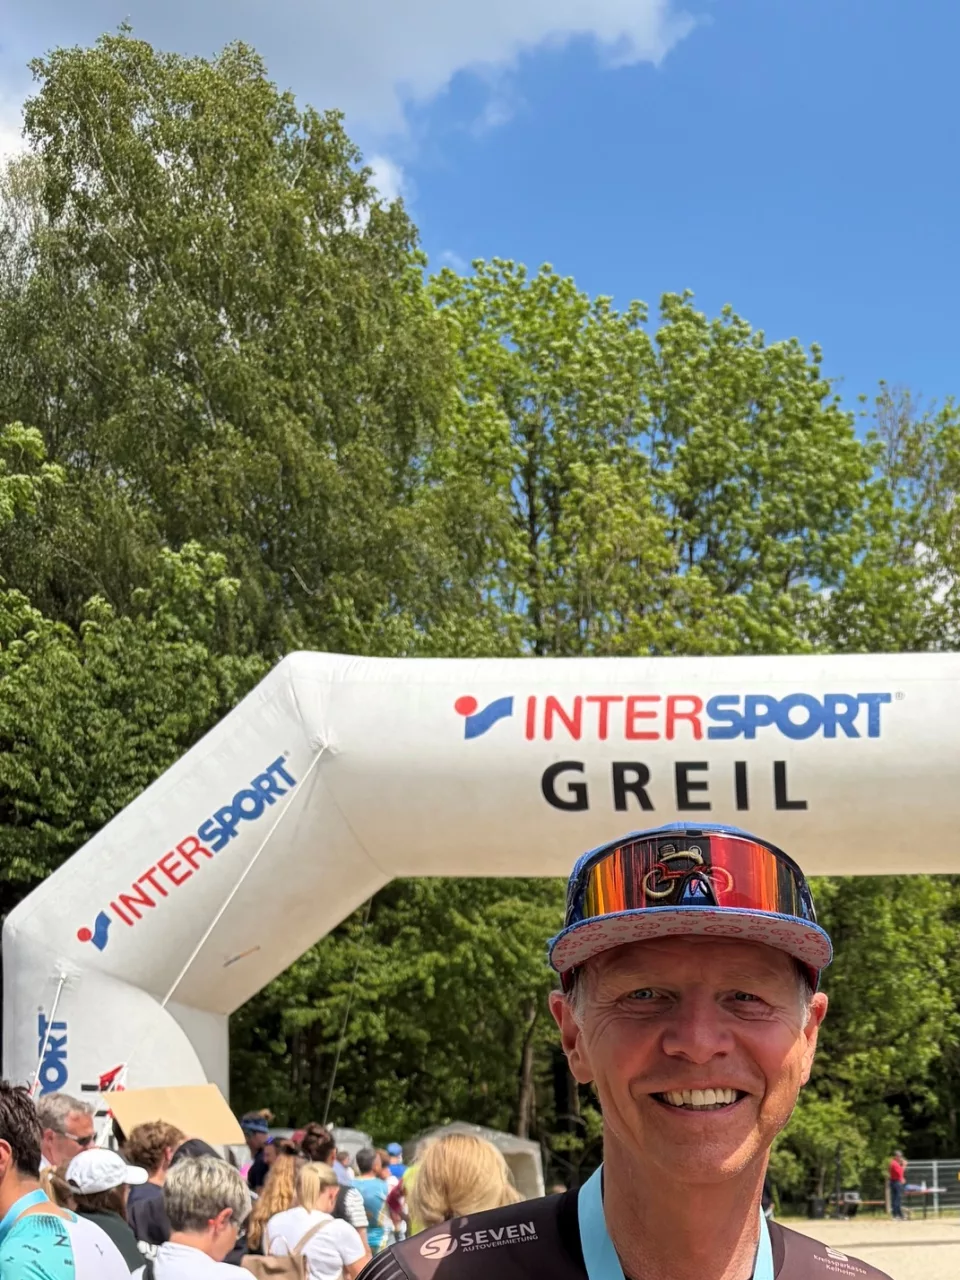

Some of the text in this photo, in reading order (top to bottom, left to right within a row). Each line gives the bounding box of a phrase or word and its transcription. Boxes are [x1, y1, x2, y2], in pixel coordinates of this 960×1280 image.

[525, 692, 892, 741] INTERSPORT
[541, 760, 808, 812] GREIL
[110, 756, 298, 927] INTERSPORT
[460, 1221, 537, 1247] SEVEN
[462, 1234, 539, 1253] AUTOVERMIETUNG
